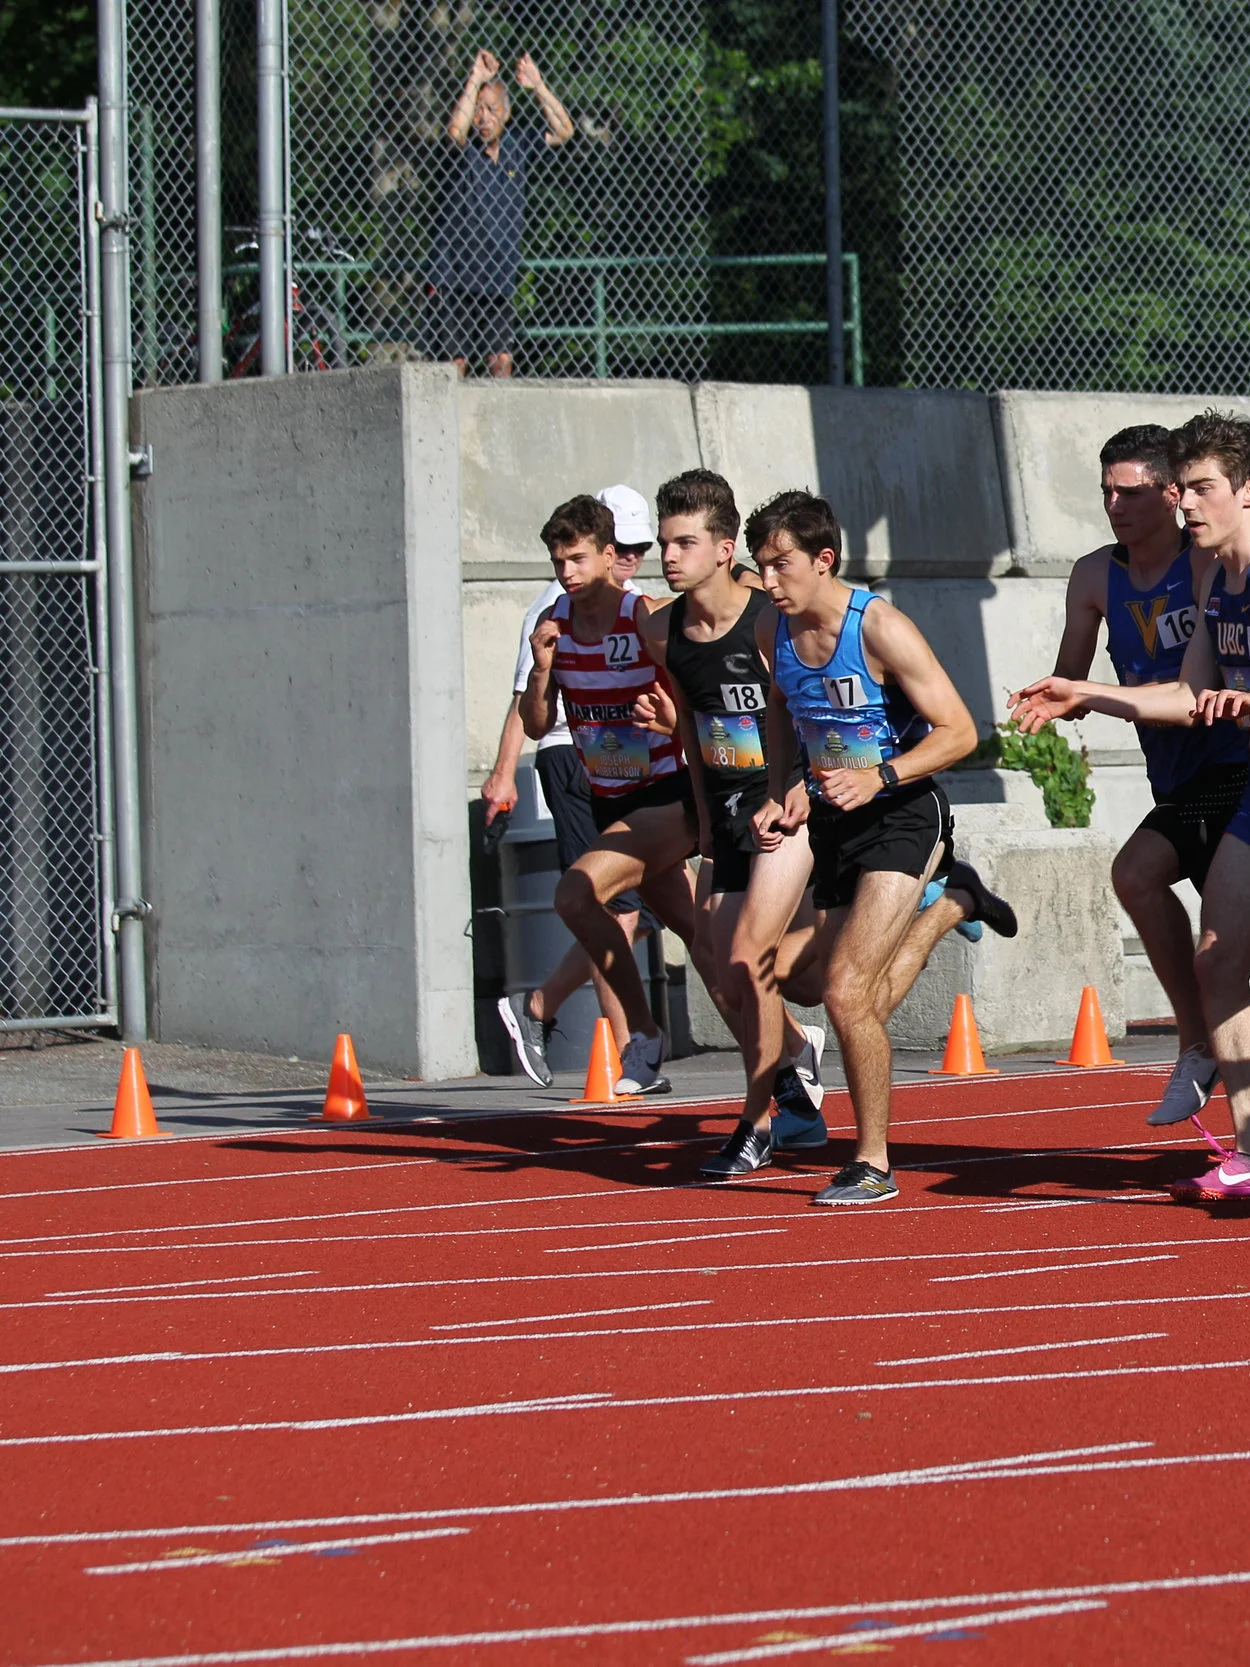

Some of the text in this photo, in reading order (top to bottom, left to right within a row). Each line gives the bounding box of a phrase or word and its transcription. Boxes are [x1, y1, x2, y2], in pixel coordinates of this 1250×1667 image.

[1164, 609, 1196, 644] 16
[1217, 623, 1245, 655] UBC
[608, 635, 633, 663] 22
[729, 686, 758, 710] 18
[830, 678, 854, 707] 17
[711, 746, 736, 765] 287
[816, 756, 841, 768] ADAM
